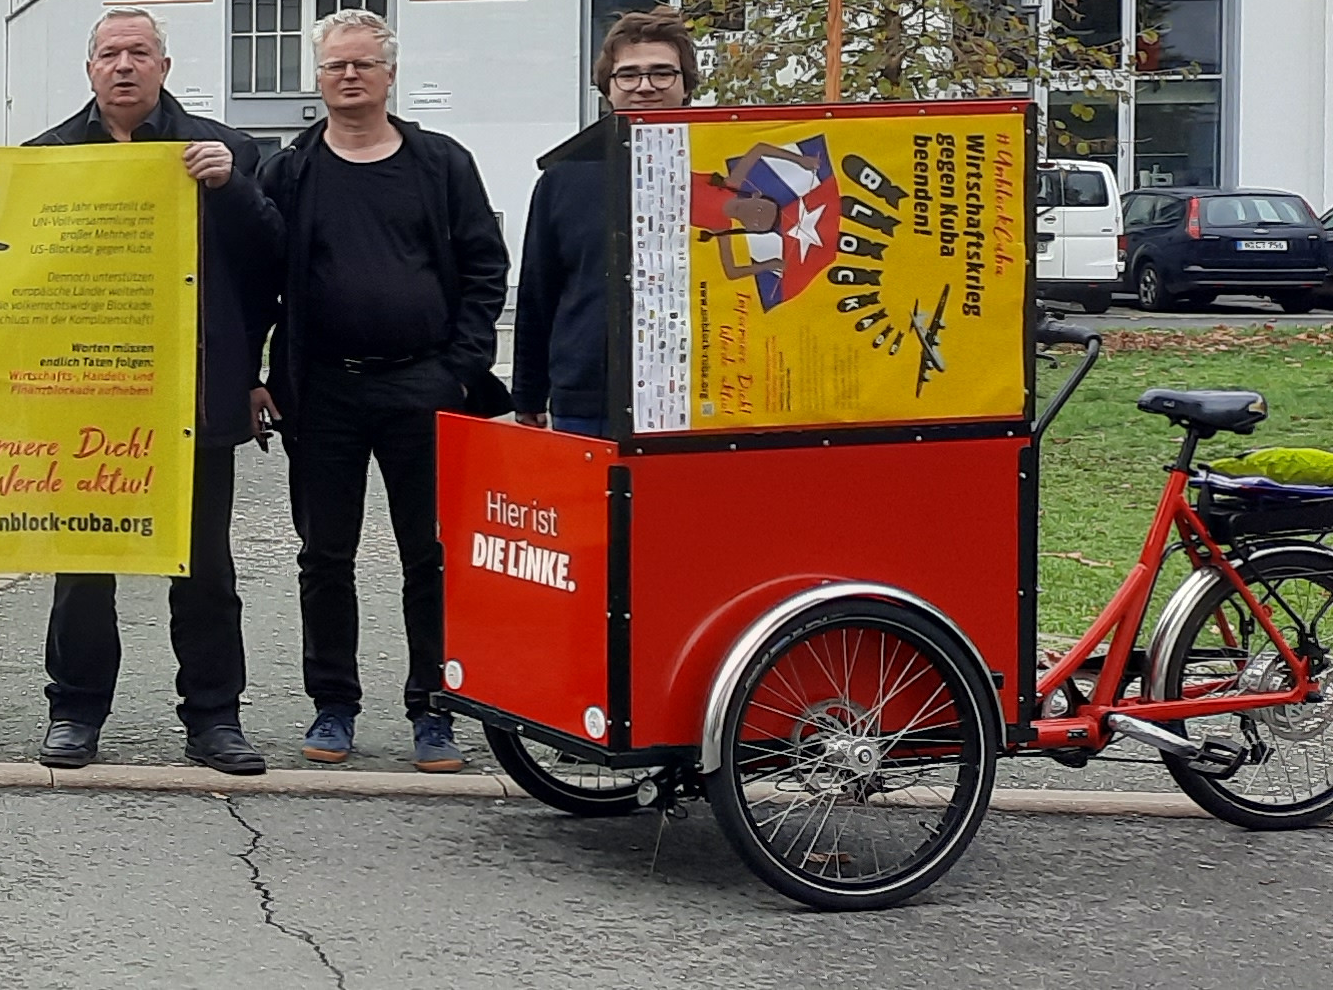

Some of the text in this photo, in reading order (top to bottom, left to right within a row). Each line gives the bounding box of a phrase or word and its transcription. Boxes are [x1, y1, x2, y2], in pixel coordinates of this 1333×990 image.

[913, 134, 933, 236] beenden!
[936, 133, 960, 257] gegen Kuba
[962, 134, 986, 317] Wirtschaftskrieg
[40, 357, 80, 367] endlich
[83, 357, 113, 367] Taten
[73, 426, 154, 459] Dich!
[76, 463, 154, 494] aktiv!
[487, 490, 558, 537] Hier ist
[472, 532, 506, 573] DIE
